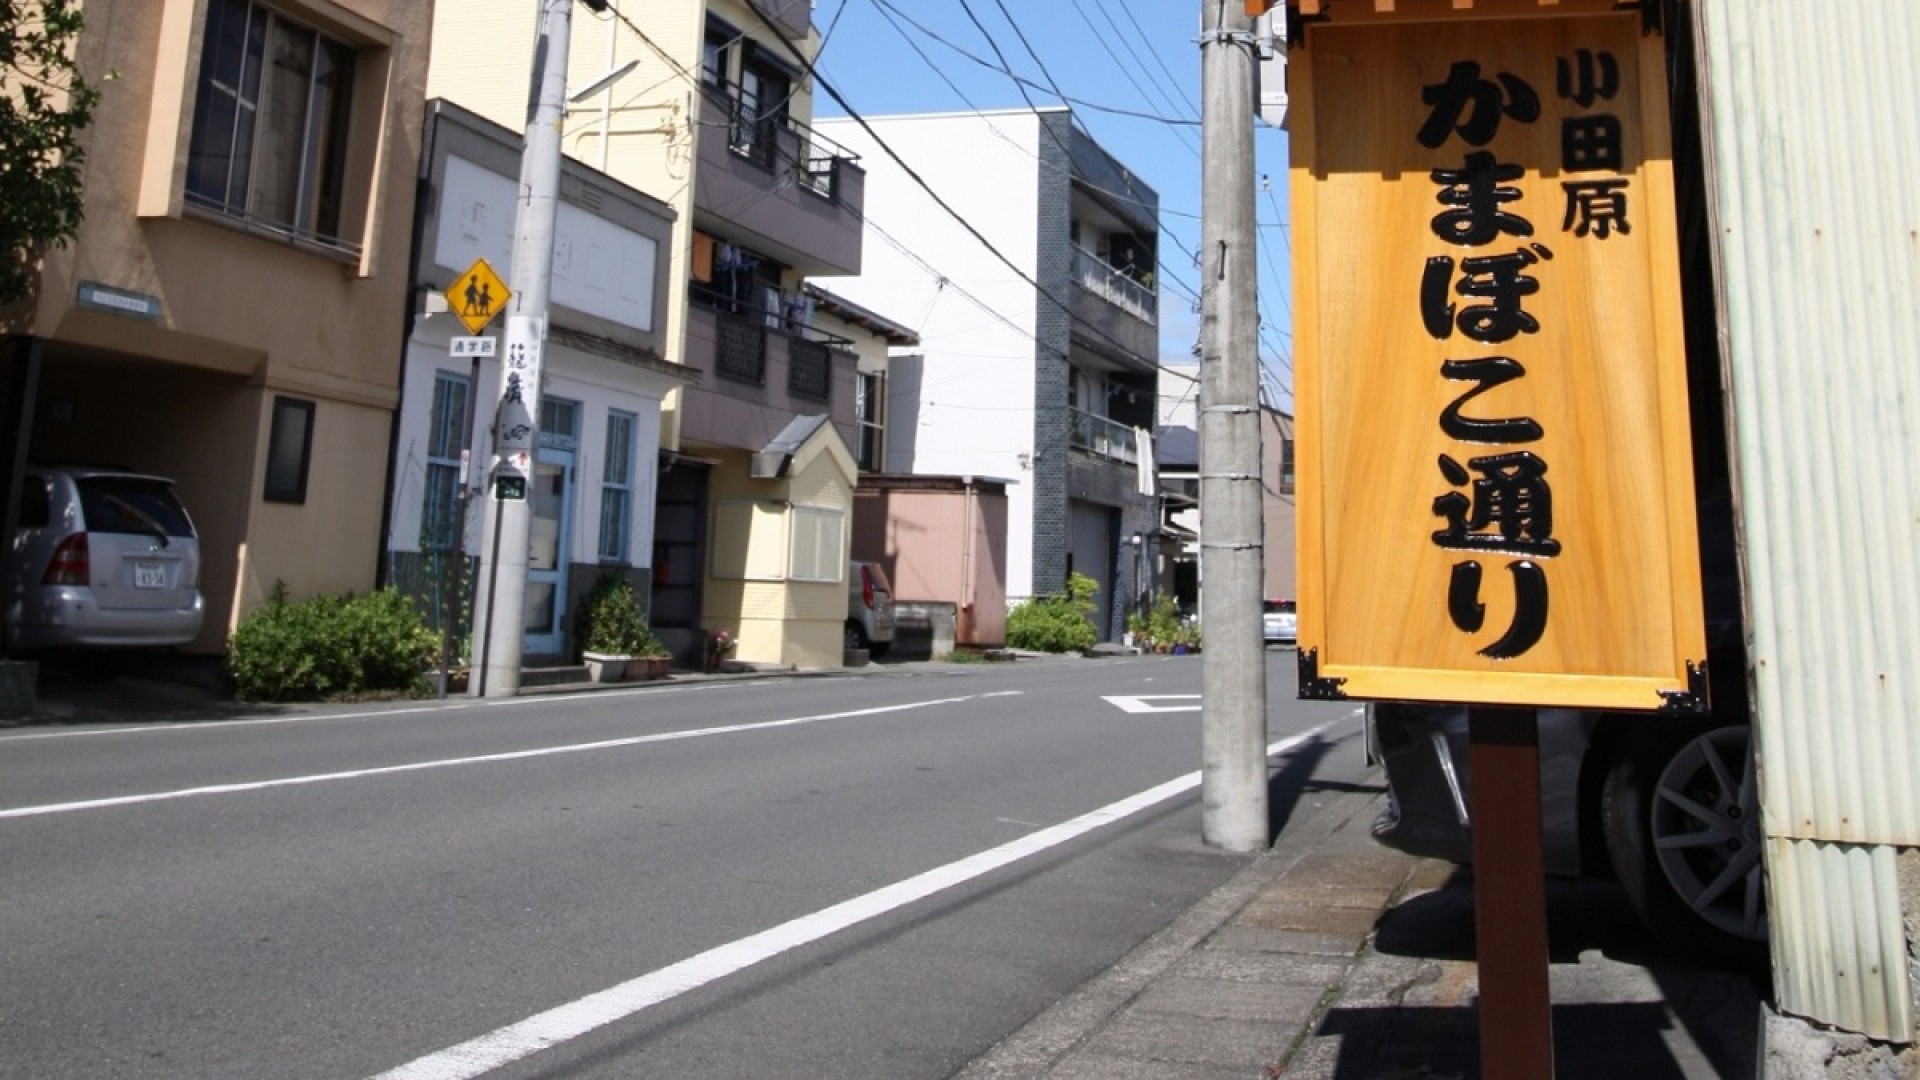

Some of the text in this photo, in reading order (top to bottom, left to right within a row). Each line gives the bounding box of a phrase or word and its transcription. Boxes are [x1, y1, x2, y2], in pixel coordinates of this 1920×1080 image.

[1554, 46, 1630, 240] 小田原
[1415, 58, 1562, 661] かまぼこ通り
